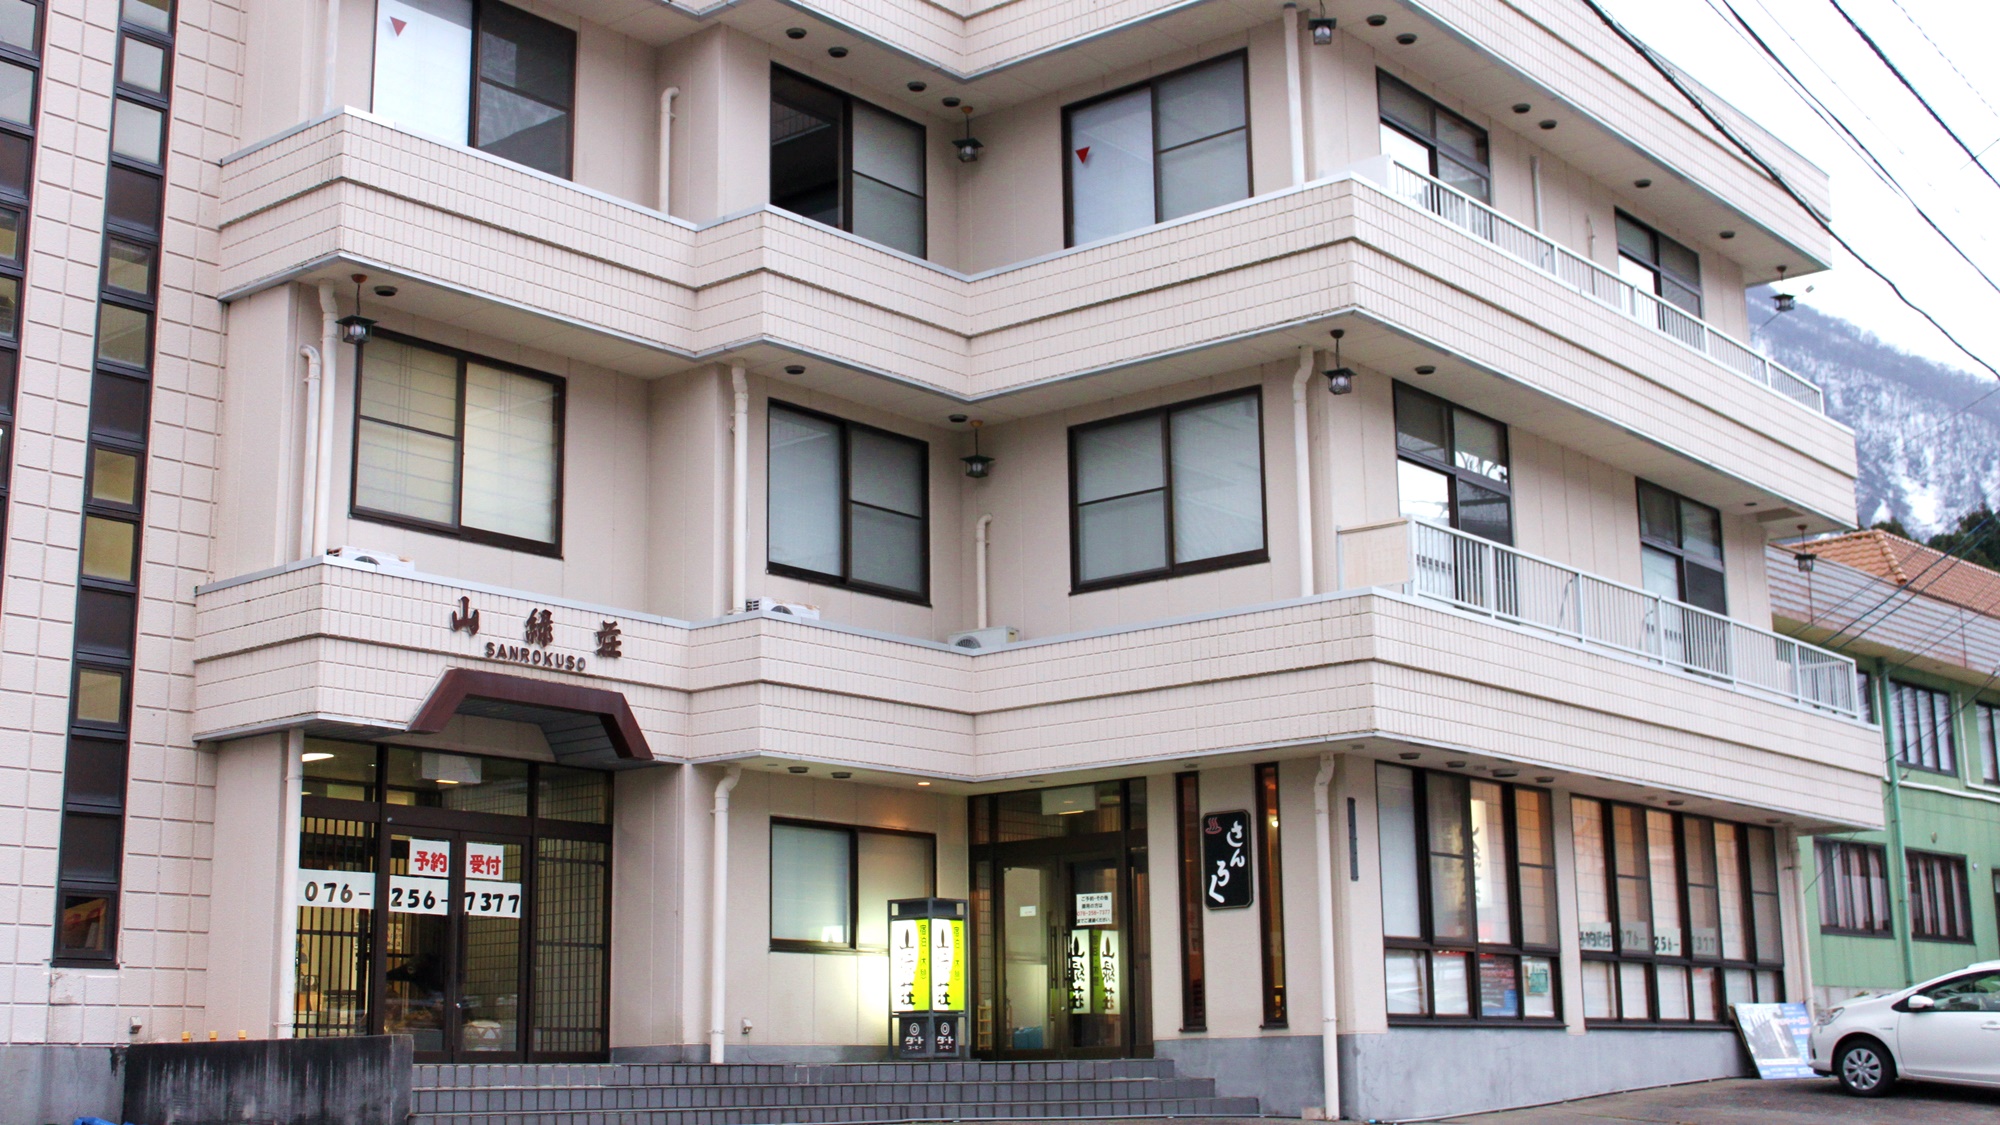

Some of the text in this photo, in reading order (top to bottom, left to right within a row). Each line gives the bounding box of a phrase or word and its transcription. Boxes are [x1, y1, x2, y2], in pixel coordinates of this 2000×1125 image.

[485, 641, 587, 672] SANROKUSO
[414, 850, 502, 876] 予約 受付
[304, 881, 371, 904] 076-
[465, 892, 521, 914] 7377
